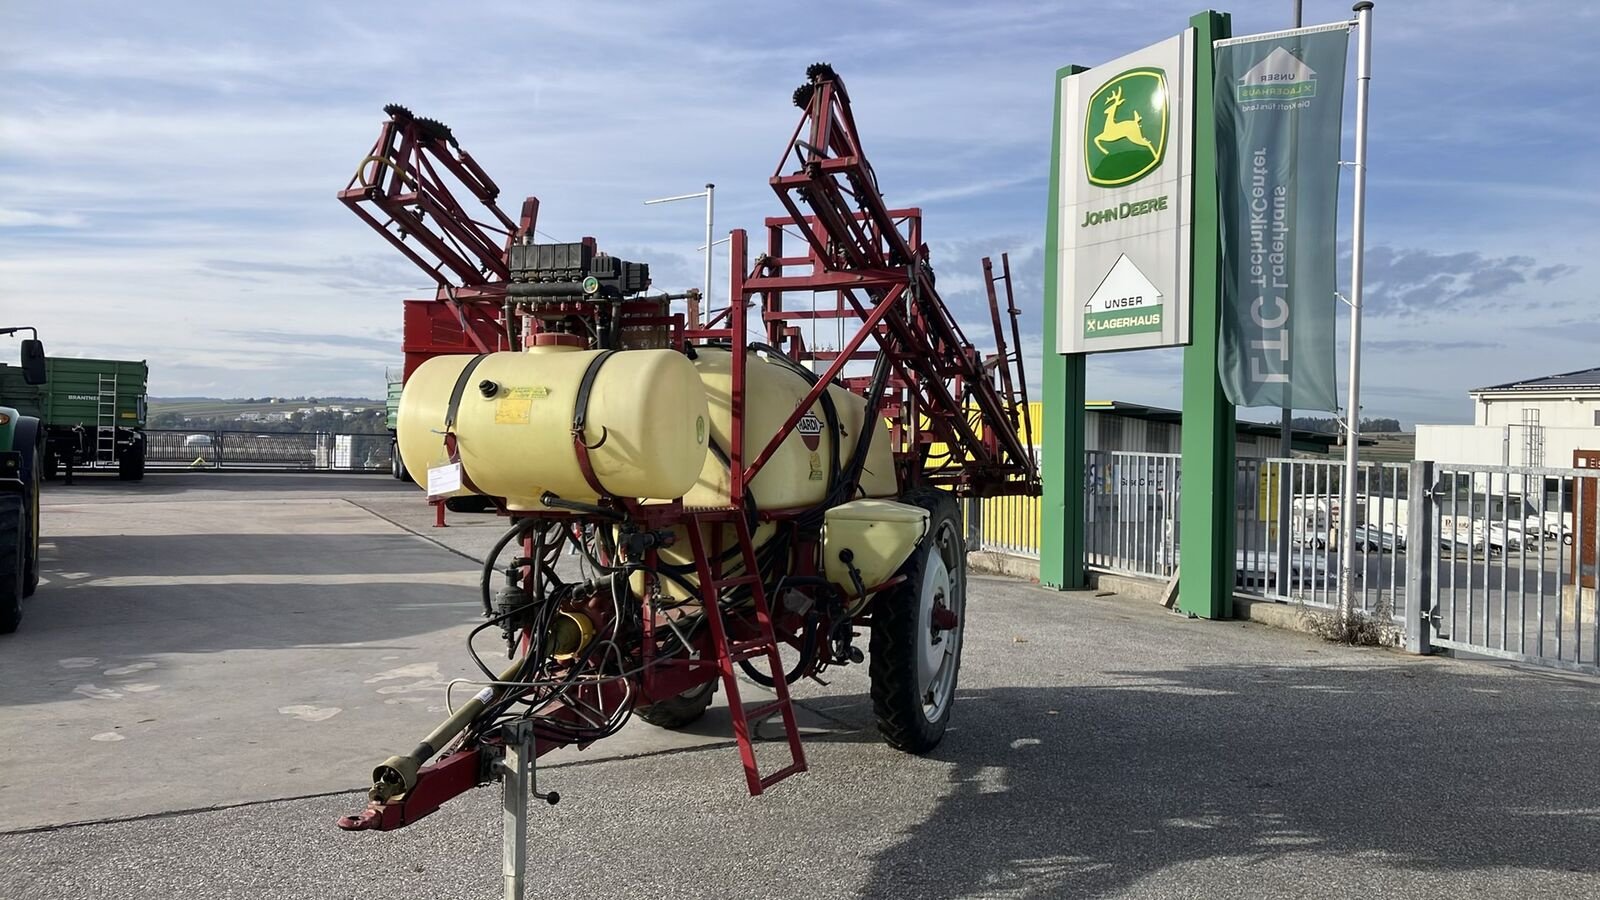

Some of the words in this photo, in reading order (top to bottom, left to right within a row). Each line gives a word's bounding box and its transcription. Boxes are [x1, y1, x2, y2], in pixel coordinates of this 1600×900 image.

[1081, 206, 1118, 228] JOHN
[1119, 195, 1168, 219] DEERE
[1104, 296, 1143, 309] UNSER
[1097, 313, 1160, 330] LAGERHAUS
[799, 418, 819, 431] HARDI
